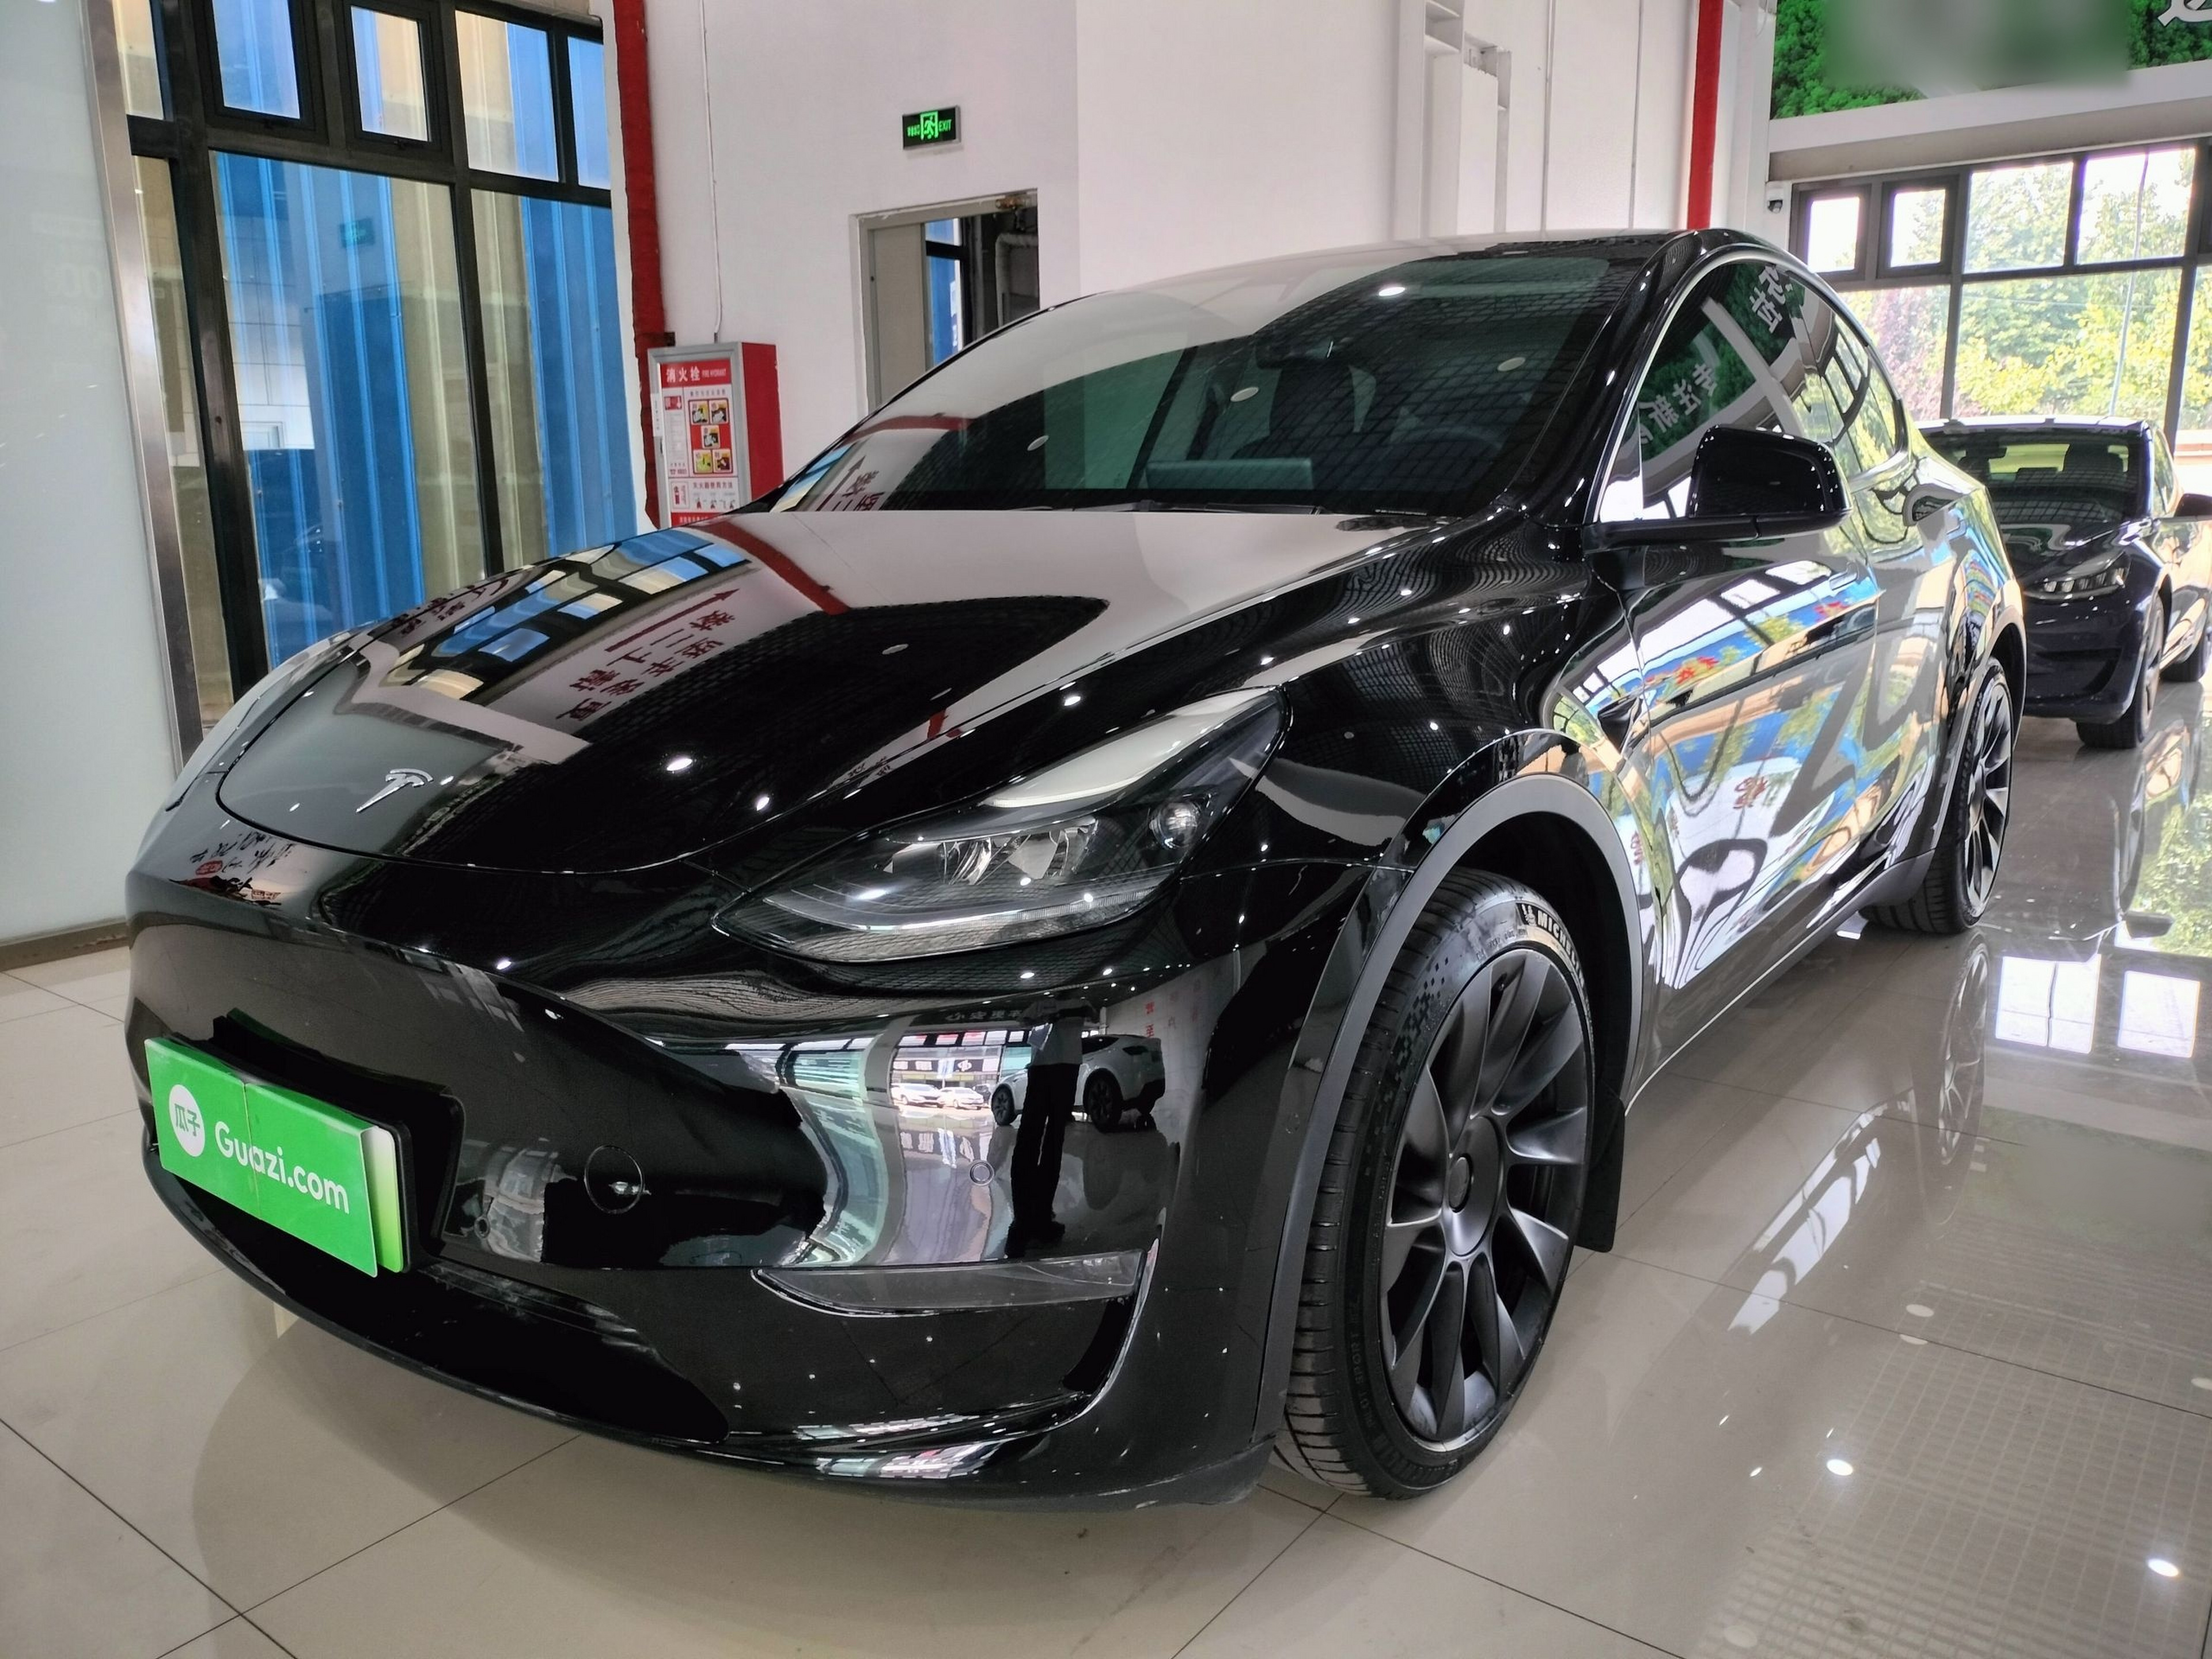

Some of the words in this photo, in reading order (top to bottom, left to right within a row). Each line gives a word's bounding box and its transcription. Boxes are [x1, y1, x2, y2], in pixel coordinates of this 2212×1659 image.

[939, 119, 952, 131] EXIT
[666, 365, 700, 382] 消火栓
[1537, 910, 1585, 988] MICHELIN
[174, 1103, 201, 1137] 瓜子
[214, 1121, 350, 1214] Guazi.com
